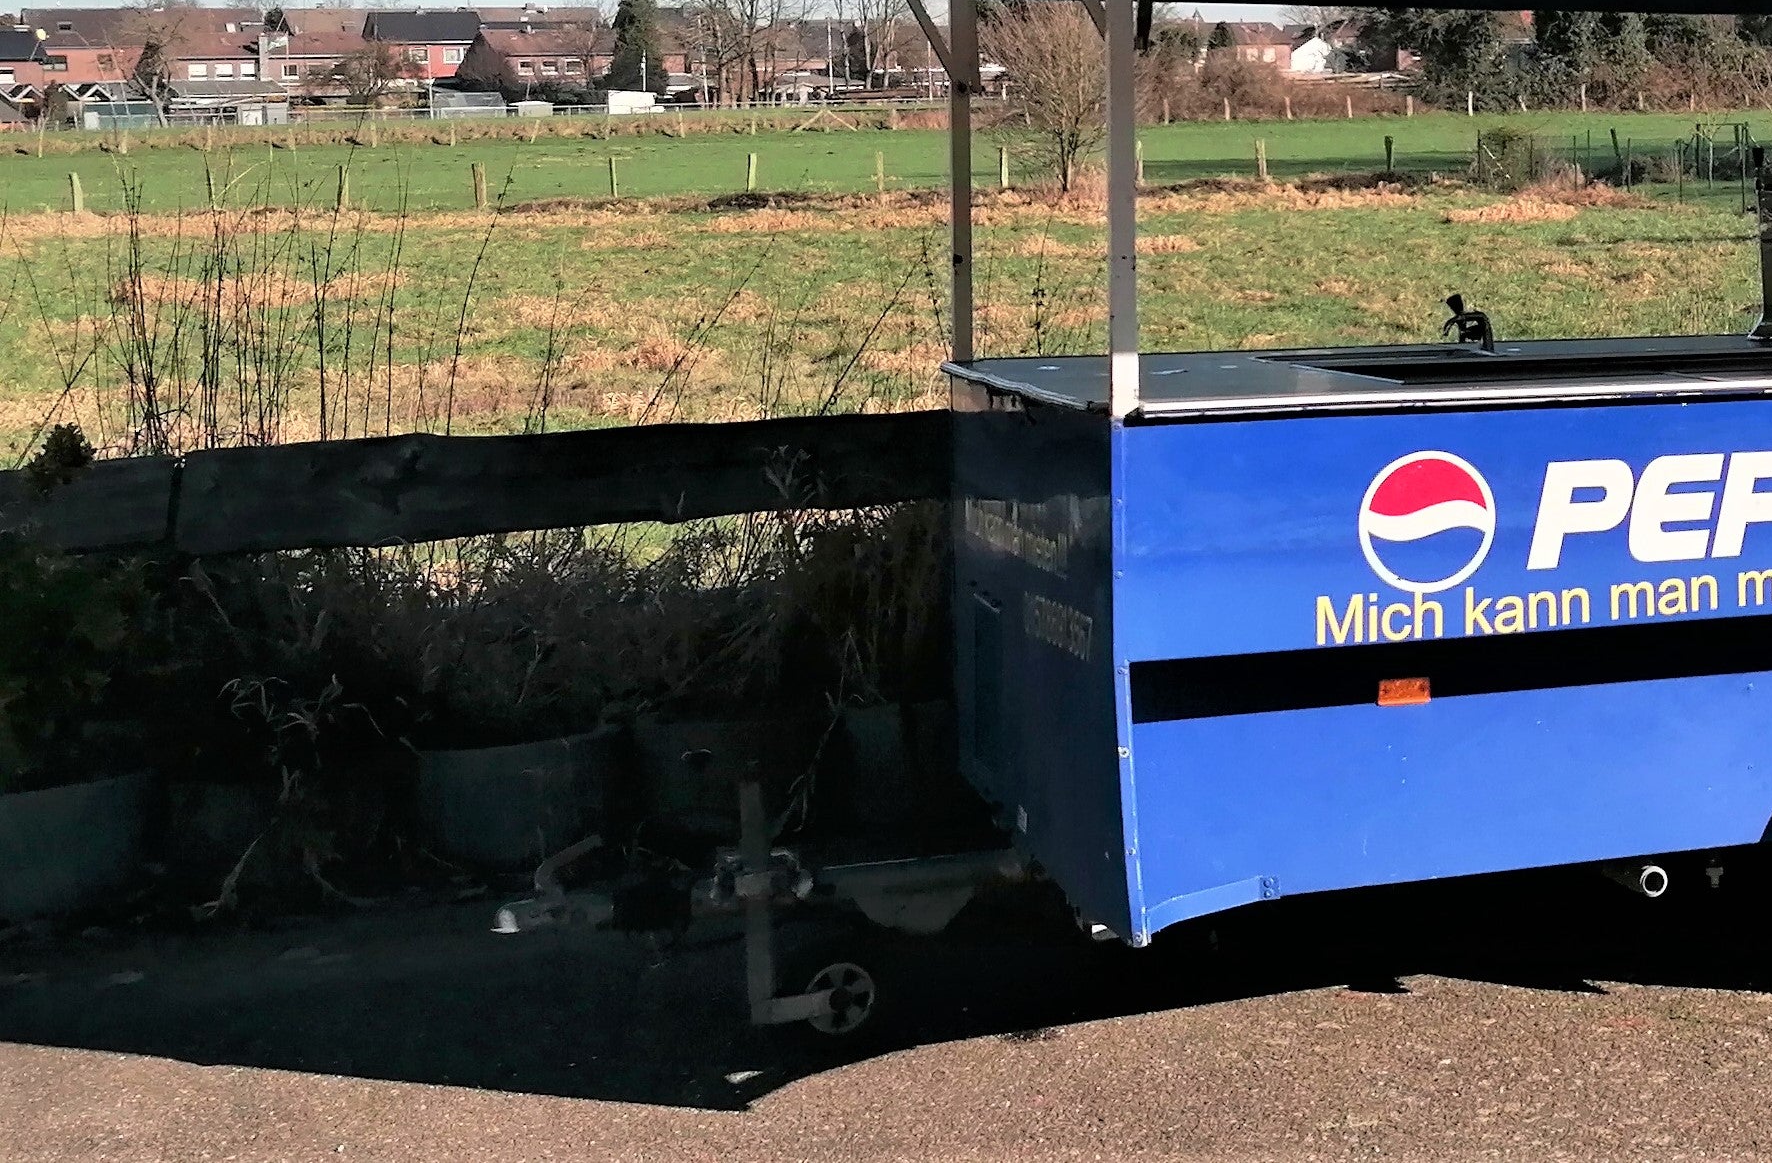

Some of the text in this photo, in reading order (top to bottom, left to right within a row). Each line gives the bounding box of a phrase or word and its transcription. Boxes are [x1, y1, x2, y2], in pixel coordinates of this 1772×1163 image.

[1315, 591, 1444, 646] Mich
[1464, 586, 1591, 635] kann
[1609, 574, 1720, 619] man
